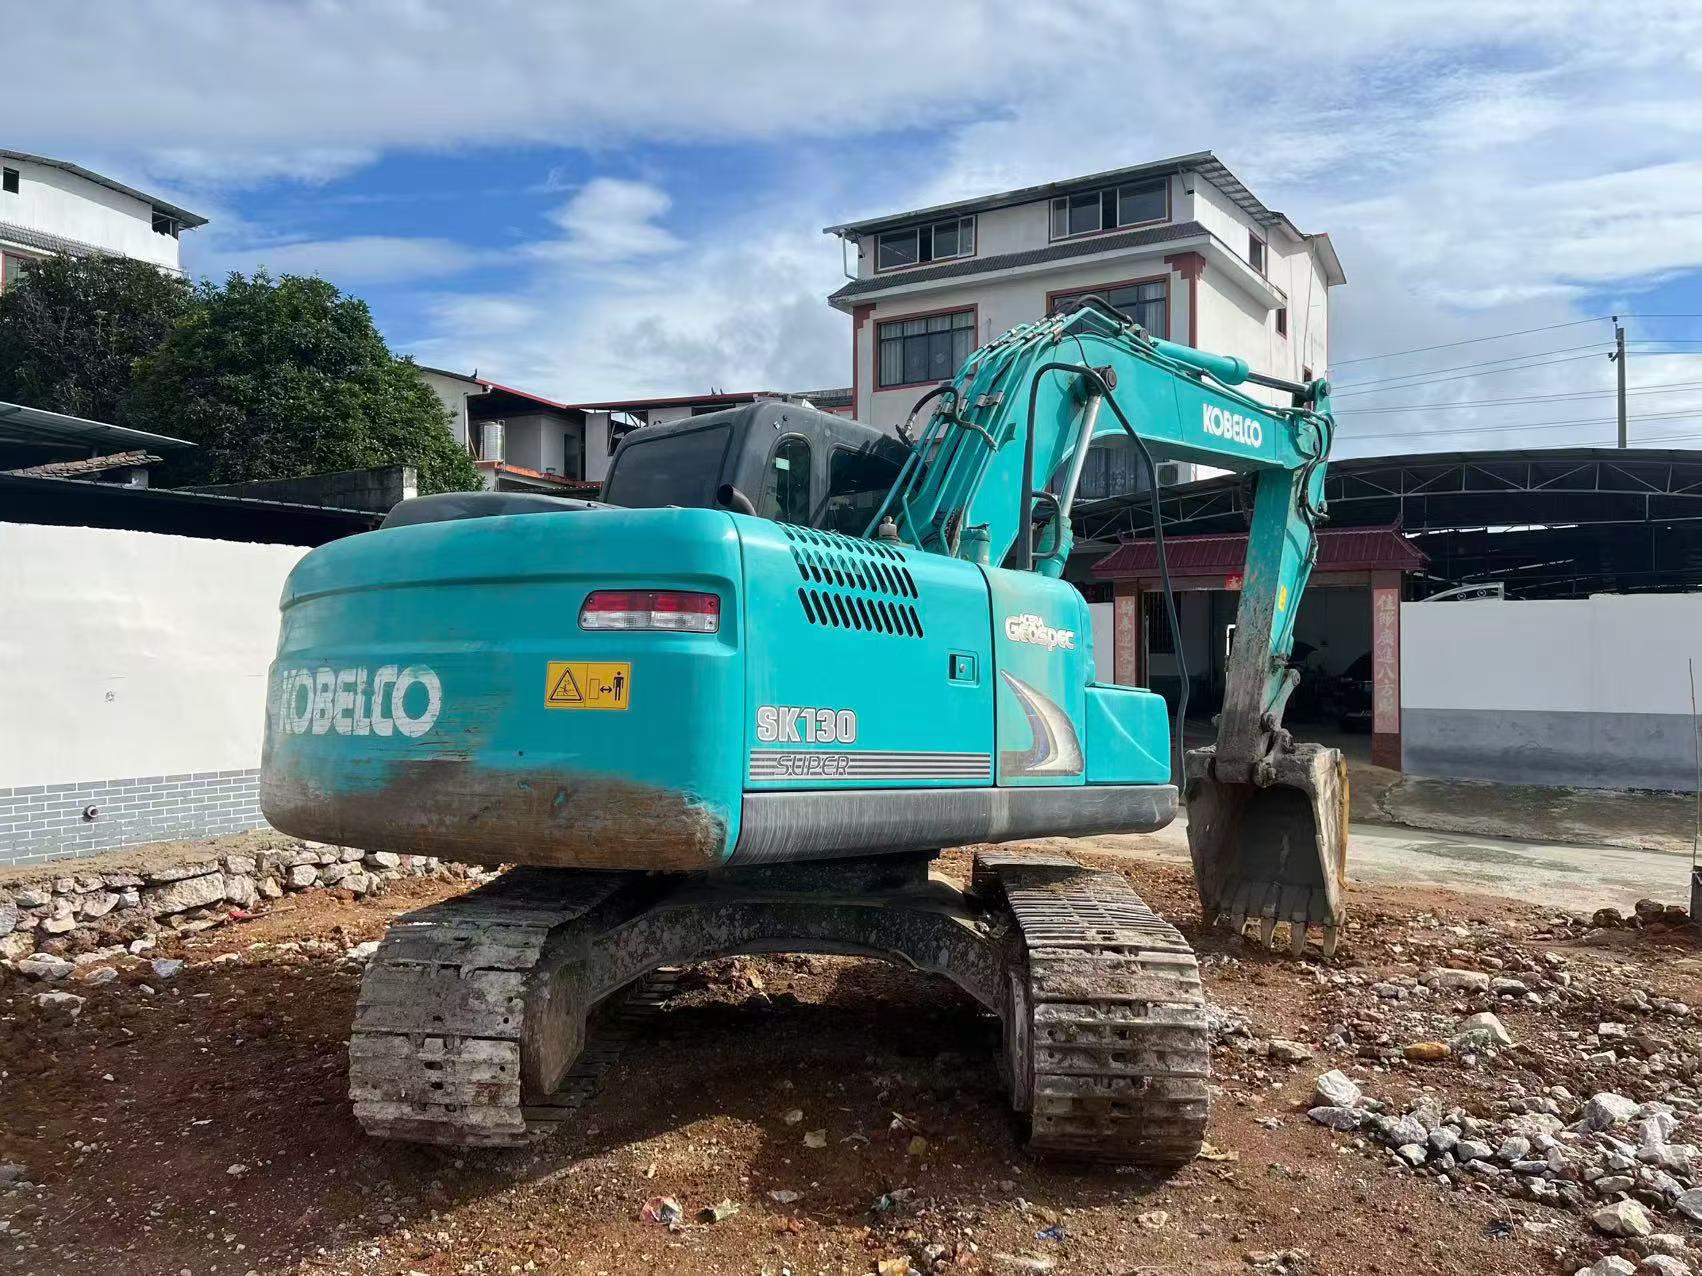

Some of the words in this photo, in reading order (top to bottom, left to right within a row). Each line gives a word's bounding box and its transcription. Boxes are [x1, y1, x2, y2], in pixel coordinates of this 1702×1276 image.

[1202, 403, 1263, 448] KOBELCO
[279, 664, 442, 738] KOBELCO
[756, 705, 857, 744] SK130
[774, 754, 851, 776] SUPER
